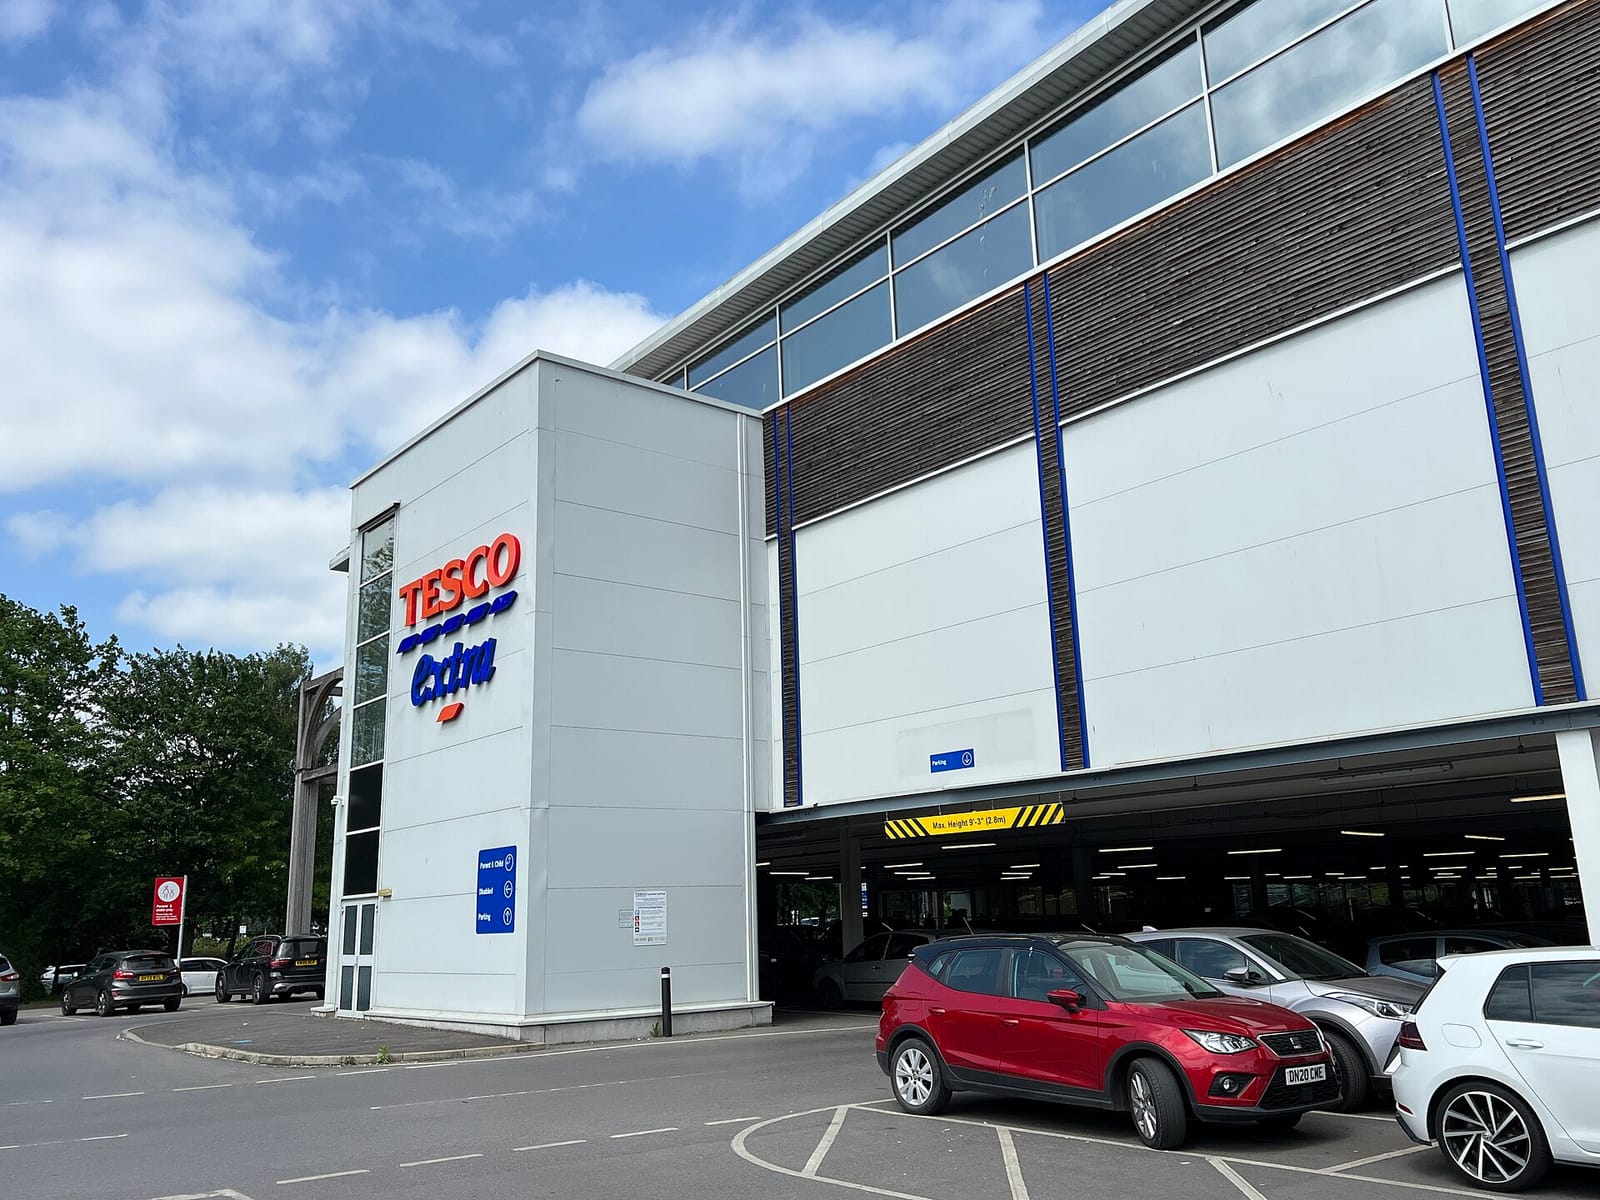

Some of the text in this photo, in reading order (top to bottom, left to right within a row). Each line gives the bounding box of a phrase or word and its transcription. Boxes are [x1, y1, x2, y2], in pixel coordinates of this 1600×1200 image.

[399, 532, 521, 627] TESCO
[411, 638, 498, 706] extra
[932, 759, 947, 767] Parking
[932, 821, 947, 830] Max.
[948, 819, 968, 829] Height
[985, 815, 1006, 825] (2.8m)
[480, 861, 491, 870] Parent
[495, 859, 504, 868] Child
[479, 887, 494, 896] Disabled
[478, 913, 491, 922] Parking
[1289, 1069, 1309, 1082] DN20
